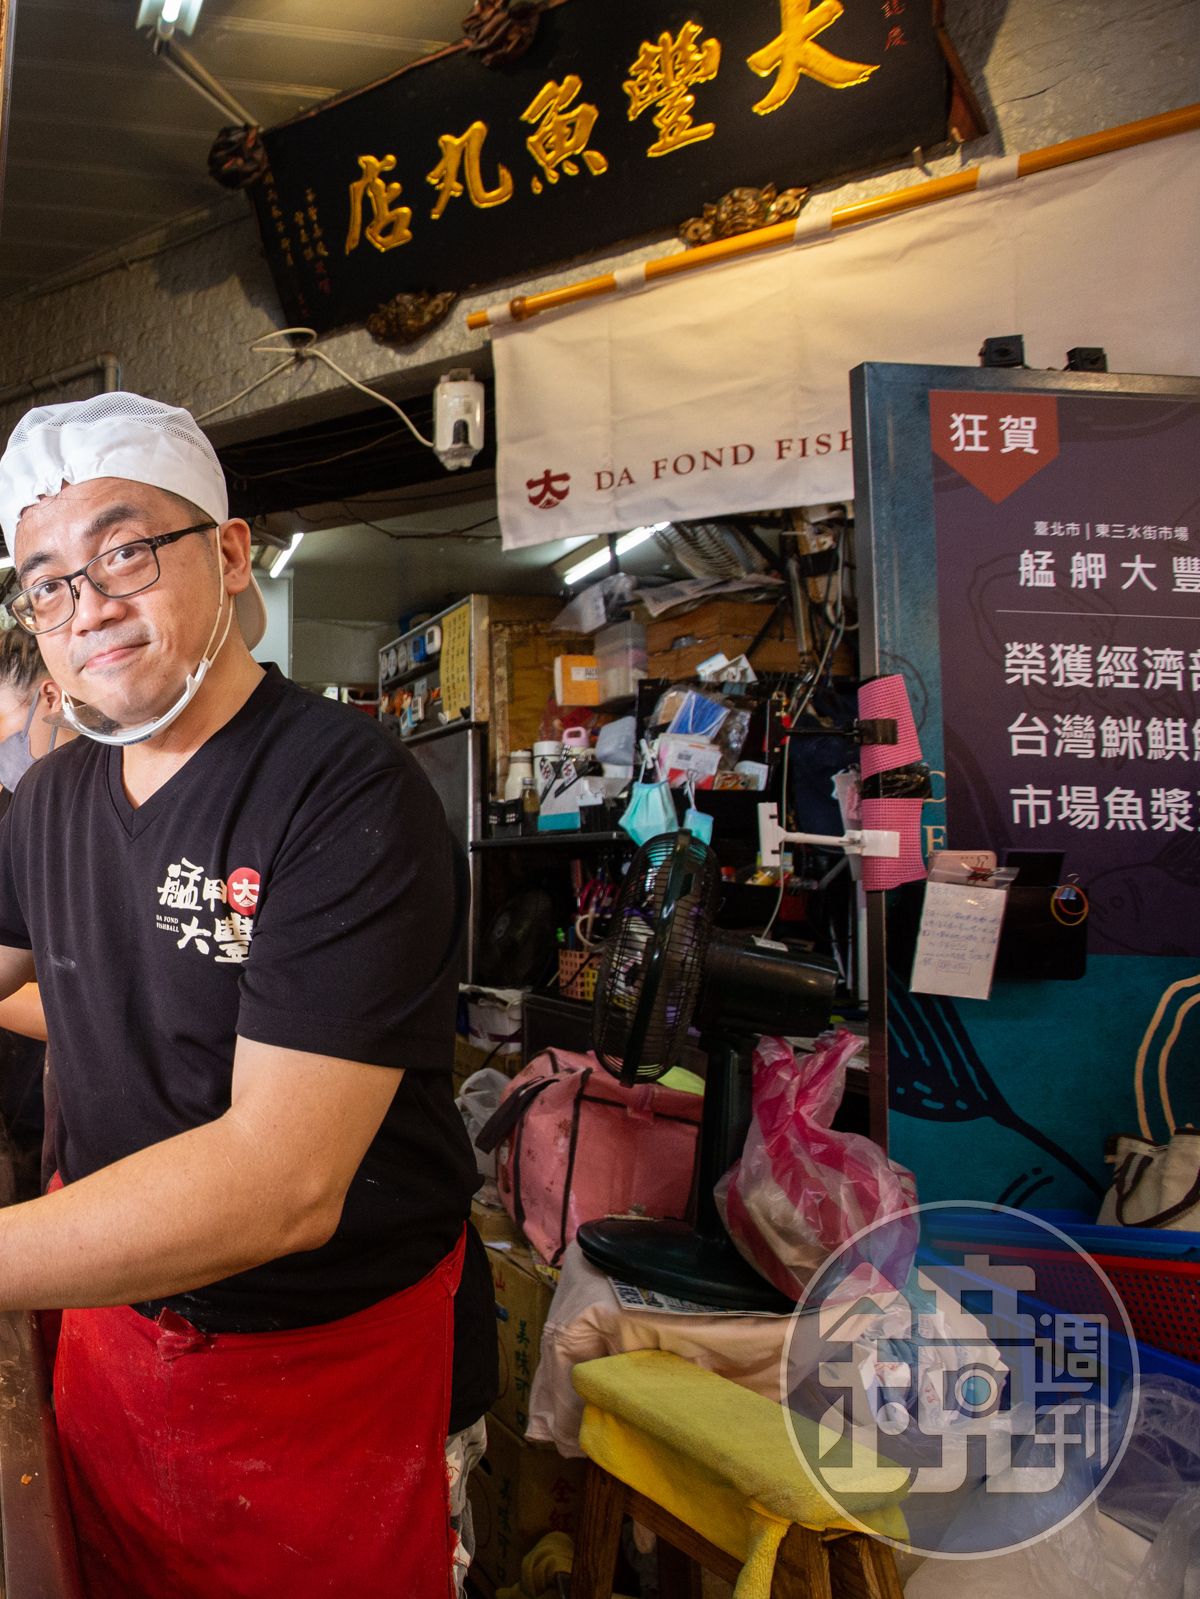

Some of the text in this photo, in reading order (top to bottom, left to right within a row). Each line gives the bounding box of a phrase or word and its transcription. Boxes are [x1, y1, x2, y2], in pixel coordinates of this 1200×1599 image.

[949, 413, 1040, 455] 狂賀
[594, 468, 636, 491] DA
[652, 443, 756, 480] FOND
[1005, 641, 1200, 692] 榮獲經濟
[1010, 784, 1200, 833] 市場魚漿
